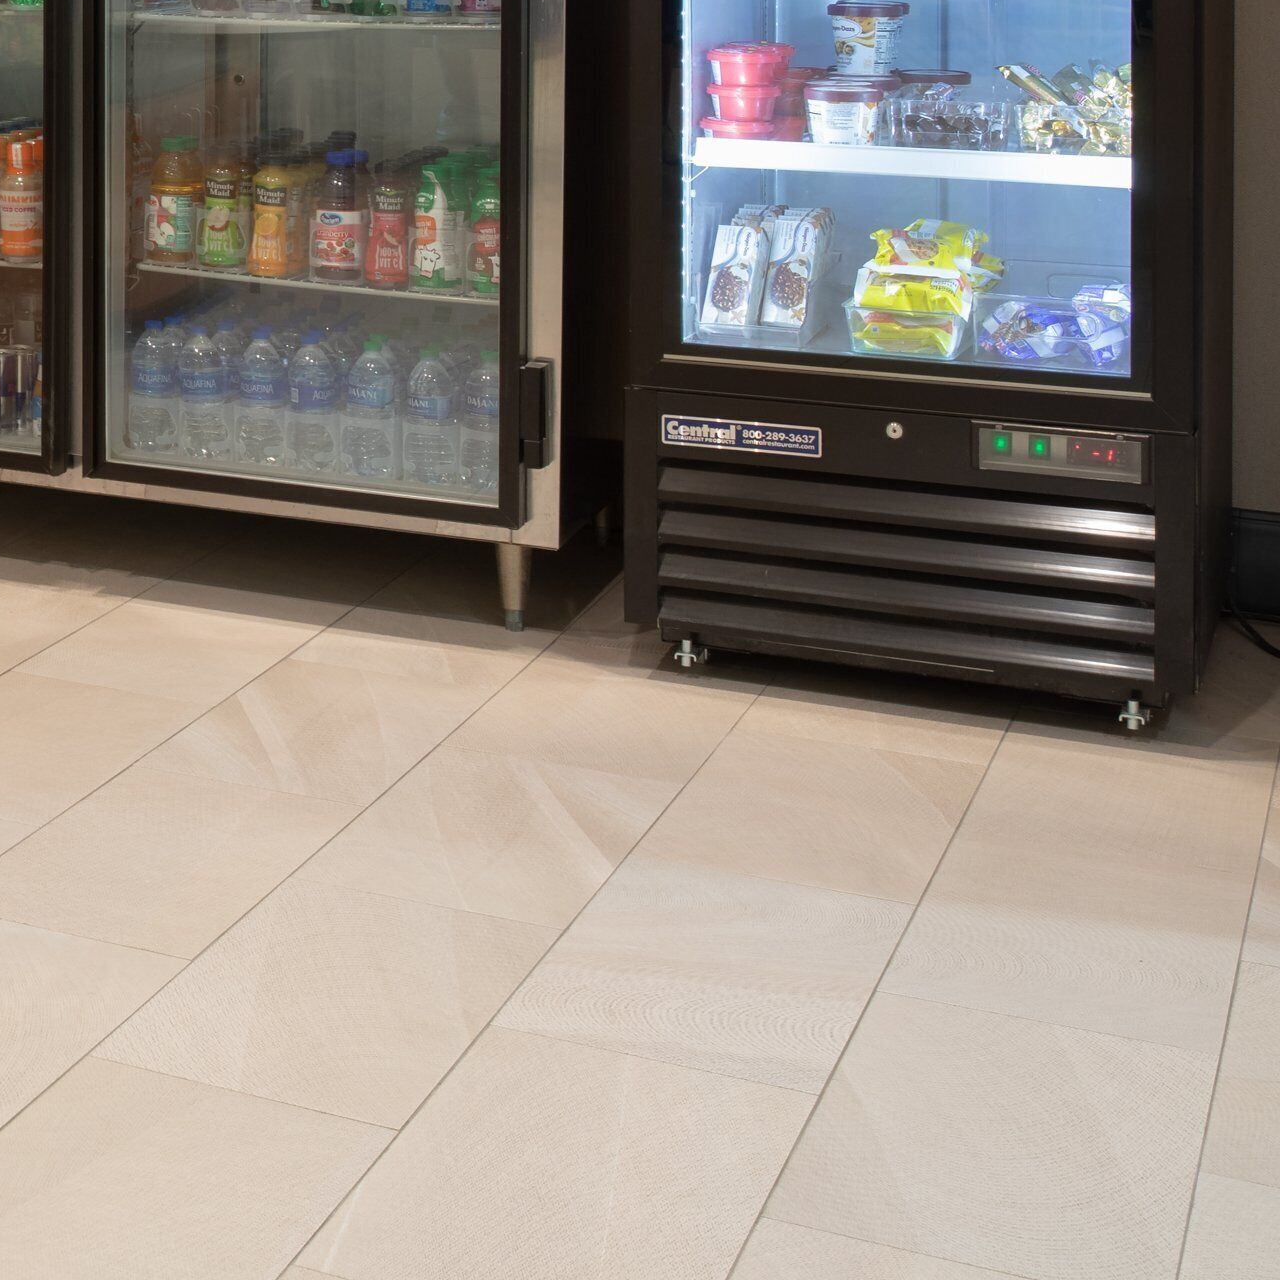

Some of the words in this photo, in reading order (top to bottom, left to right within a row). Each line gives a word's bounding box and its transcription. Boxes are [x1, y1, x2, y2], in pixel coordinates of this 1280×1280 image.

[206, 180, 234, 190] Minute
[210, 188, 230, 197] Maid
[256, 188, 285, 198] Minute
[259, 195, 281, 204] Maid
[376, 194, 404, 204] Minute
[378, 202, 401, 210] Maid
[666, 420, 736, 440] Central
[668, 434, 704, 442] RESTAURANT
[705, 436, 736, 445] PRODUCTS
[742, 429, 816, 444] 800-289-3637
[742, 438, 816, 450] centralrestaurant.com
